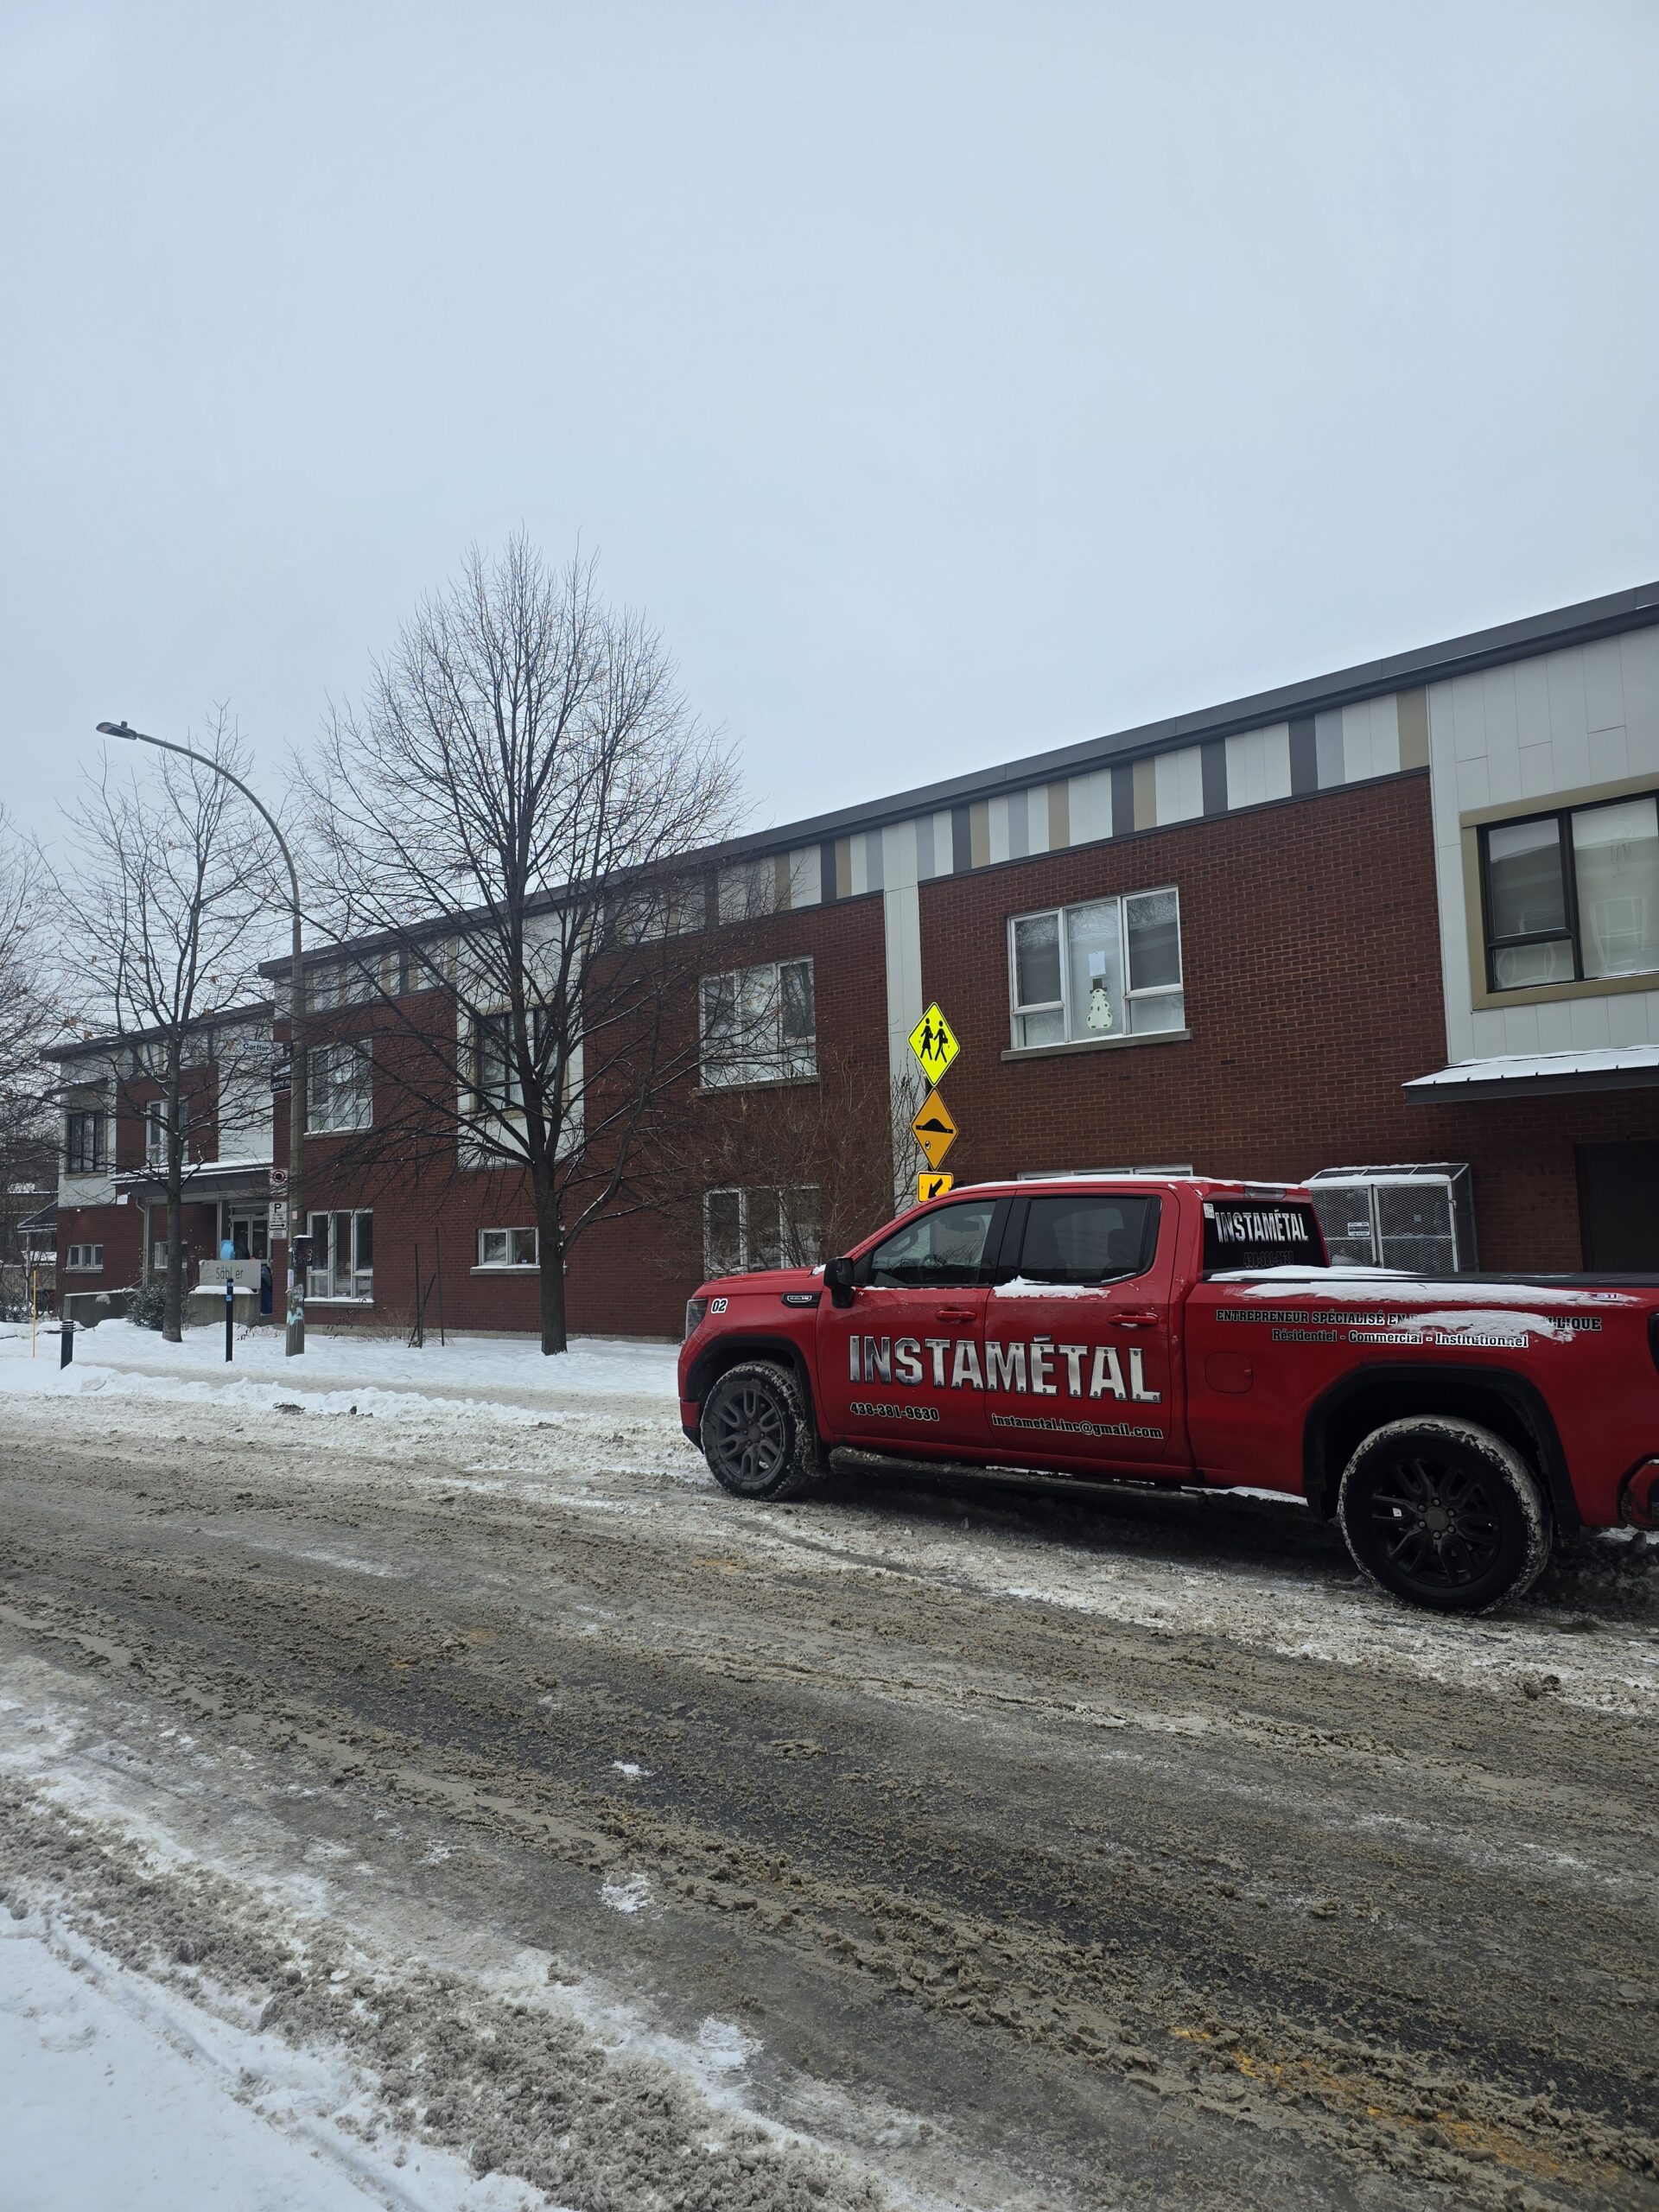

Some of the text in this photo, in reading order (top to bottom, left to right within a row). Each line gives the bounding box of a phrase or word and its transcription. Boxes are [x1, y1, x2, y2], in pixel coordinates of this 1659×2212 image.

[274, 1203, 282, 1213] P
[1215, 1209, 1309, 1243] INSTAMÉTAL
[215, 1265, 244, 1280] Sabler
[711, 1299, 728, 1313] 02
[1217, 1310, 1309, 1324] ENTREPRENEUR
[1312, 1309, 1384, 1325] SPÉCIALISÉ
[1273, 1329, 1338, 1342] Résidentiel
[1349, 1331, 1423, 1344] Commercial
[849, 1334, 1161, 1403] INSTAMÉTAL
[849, 1402, 939, 1422] 438-381-9630
[991, 1413, 1164, 1440] instametal.inc@gmail.com
